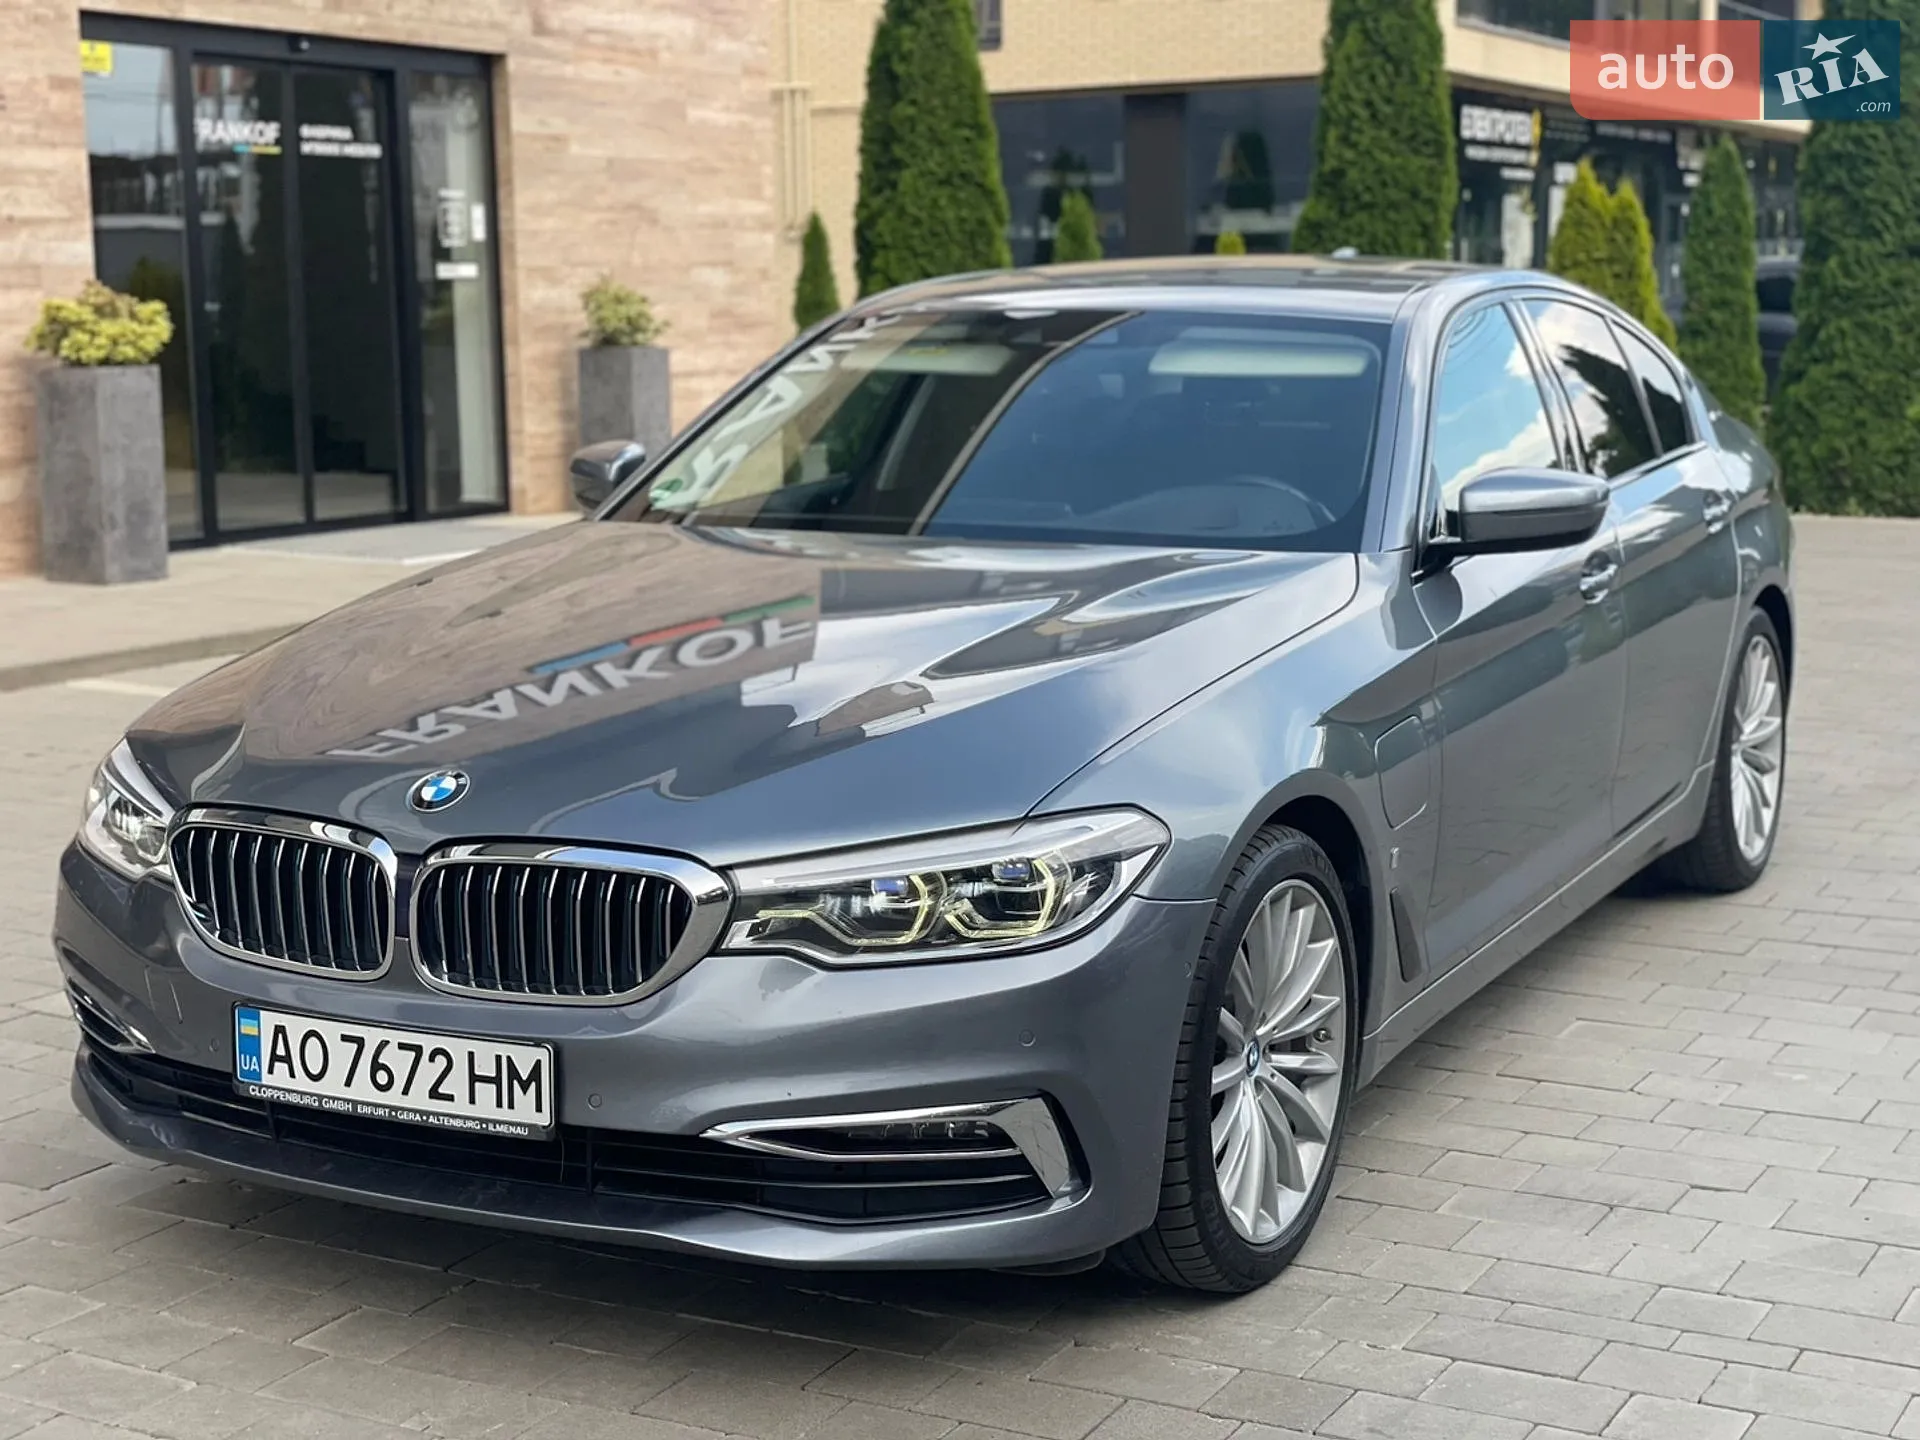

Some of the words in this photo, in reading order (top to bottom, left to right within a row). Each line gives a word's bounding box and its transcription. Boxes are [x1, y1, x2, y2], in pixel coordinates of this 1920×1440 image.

[194, 117, 281, 145] RANKOF
[241, 1054, 260, 1073] UA
[267, 1023, 330, 1083] AO
[340, 1033, 455, 1103] 7672
[467, 1050, 543, 1114] HM
[249, 1085, 319, 1107] CLOPPENBURG
[322, 1098, 352, 1113] GMBH
[357, 1105, 389, 1117] ERFURT
[397, 1110, 421, 1122] GERA
[428, 1115, 481, 1130] ALTENBURG
[488, 1123, 528, 1136] ILMENAU
